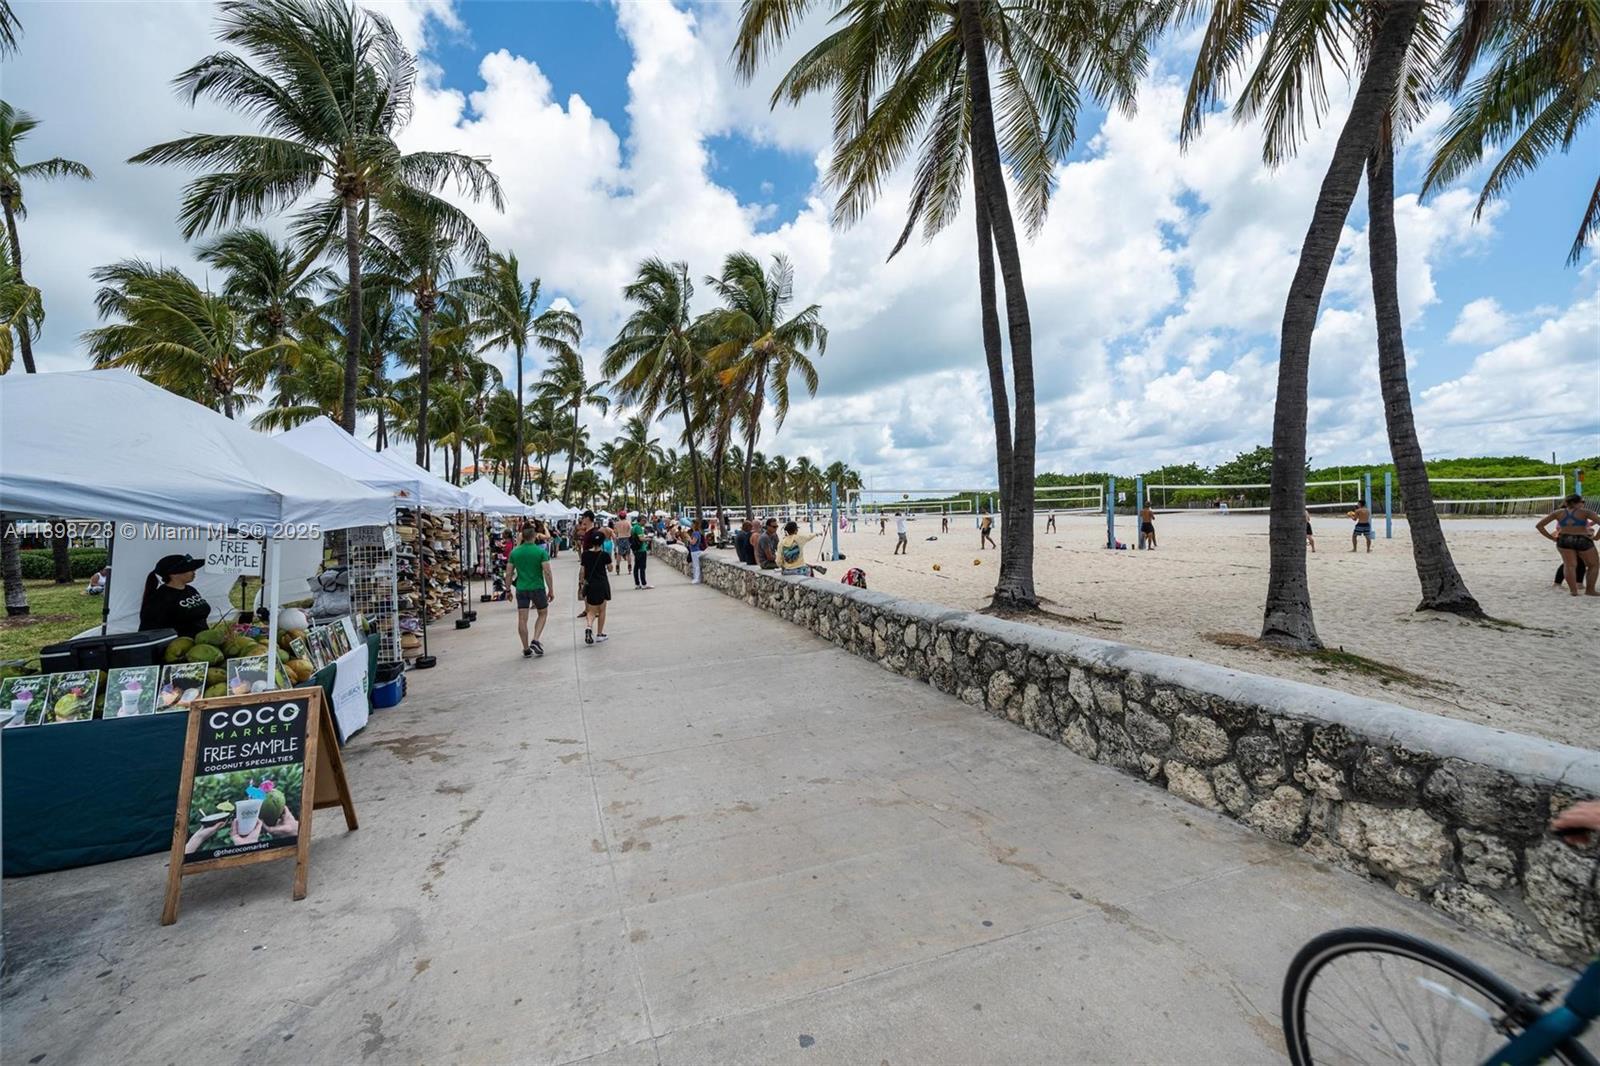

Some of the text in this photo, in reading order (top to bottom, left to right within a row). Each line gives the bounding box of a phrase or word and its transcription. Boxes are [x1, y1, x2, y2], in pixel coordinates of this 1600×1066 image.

[220, 540, 249, 554] FREE
[207, 553, 259, 568] SAMPLE
[209, 702, 300, 729] COCO
[215, 723, 292, 740] MARKET
[203, 737, 298, 763] FREE SAMPLE
[204, 754, 294, 772] COCONUT SPECIALTIES
[213, 842, 270, 858] @thecocomarket
